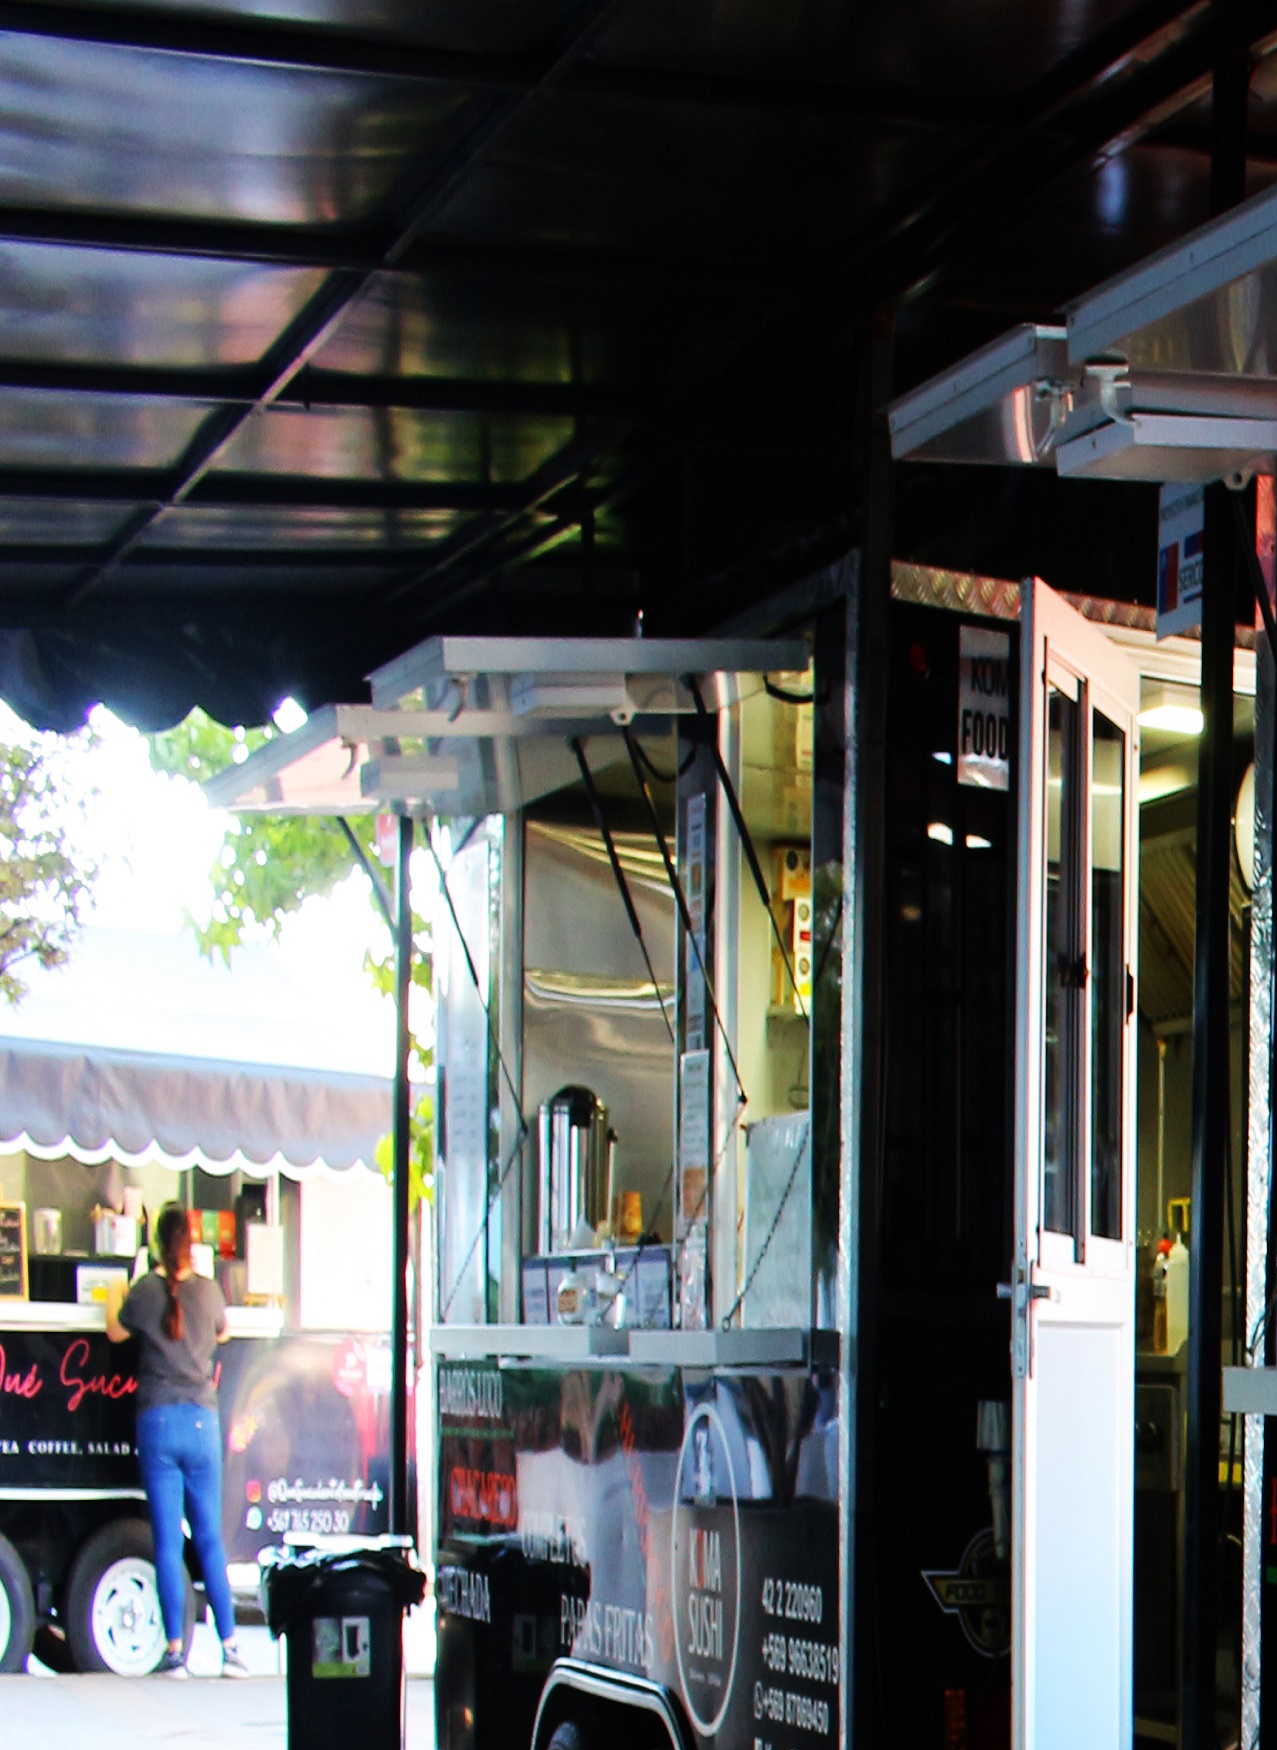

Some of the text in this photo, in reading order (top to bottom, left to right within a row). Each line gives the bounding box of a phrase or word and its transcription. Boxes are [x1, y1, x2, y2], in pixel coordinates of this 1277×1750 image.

[961, 709, 1009, 761] FOOD
[689, 1526, 722, 1594] KOMA
[687, 1593, 723, 1661] SUSHI
[762, 1577, 774, 1616] 42
[603, 1603, 654, 1668] FRITAS
